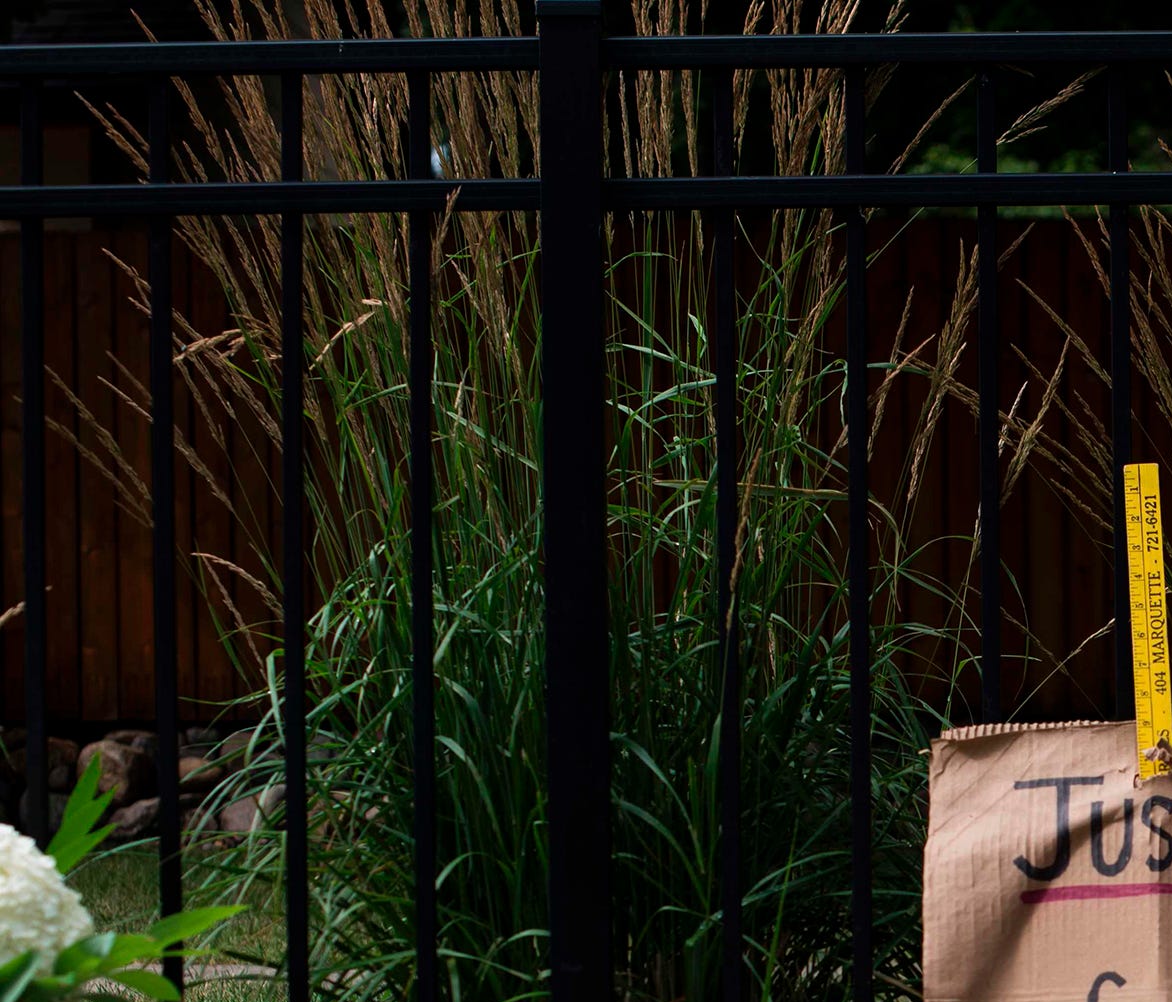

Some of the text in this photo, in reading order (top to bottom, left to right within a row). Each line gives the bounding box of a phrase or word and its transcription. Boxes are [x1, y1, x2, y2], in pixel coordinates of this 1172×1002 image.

[1144, 494, 1159, 552] 721-6421
[1148, 571, 1165, 664] MARQUETTE
[1154, 671, 1166, 695] 404
